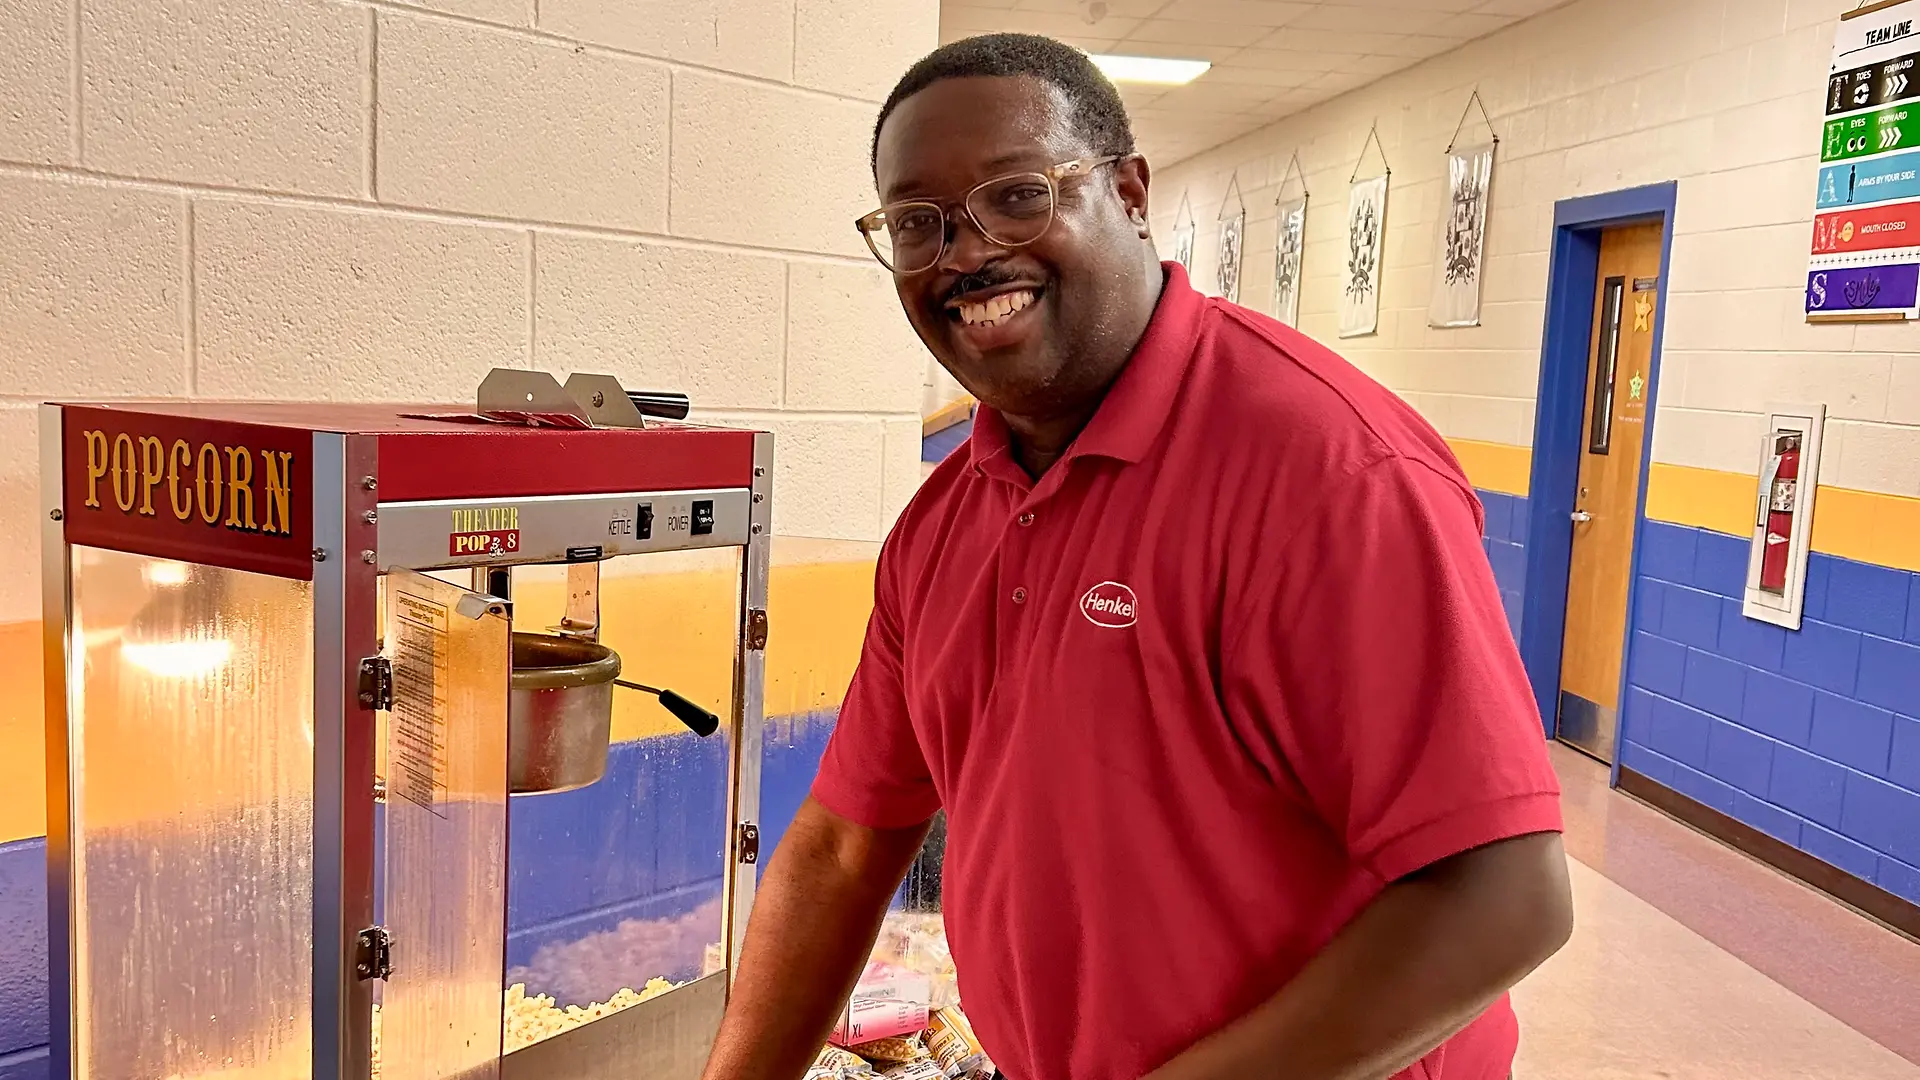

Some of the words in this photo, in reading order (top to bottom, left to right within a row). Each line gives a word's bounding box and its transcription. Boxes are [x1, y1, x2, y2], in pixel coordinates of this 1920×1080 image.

[1866, 26, 1891, 45] TEAM
[1893, 19, 1913, 38] LINE
[1856, 69, 1872, 81] TOES
[1883, 59, 1914, 75] FORWARD
[1829, 74, 1849, 111] T
[1850, 117, 1866, 128] EYES
[1878, 111, 1908, 125] FORWARD
[1822, 121, 1844, 160] E
[1818, 169, 1838, 203] A
[1858, 177, 1875, 187] ARMS
[1875, 175, 1884, 185] BY
[1883, 173, 1900, 183] YOUR
[1900, 170, 1916, 181] SIDE
[1812, 216, 1840, 251] M
[1861, 223, 1881, 234] MOUTH
[1881, 221, 1906, 231] CLOSED
[1809, 273, 1828, 308] S
[84, 429, 292, 534] POPCORN
[452, 507, 519, 533] THEATER
[608, 519, 631, 535] KETTLE
[668, 515, 689, 531] POWER
[456, 534, 490, 552] POP
[507, 532, 516, 548] 8
[1085, 592, 1135, 618] Henkel
[852, 1023, 863, 1039] XL
